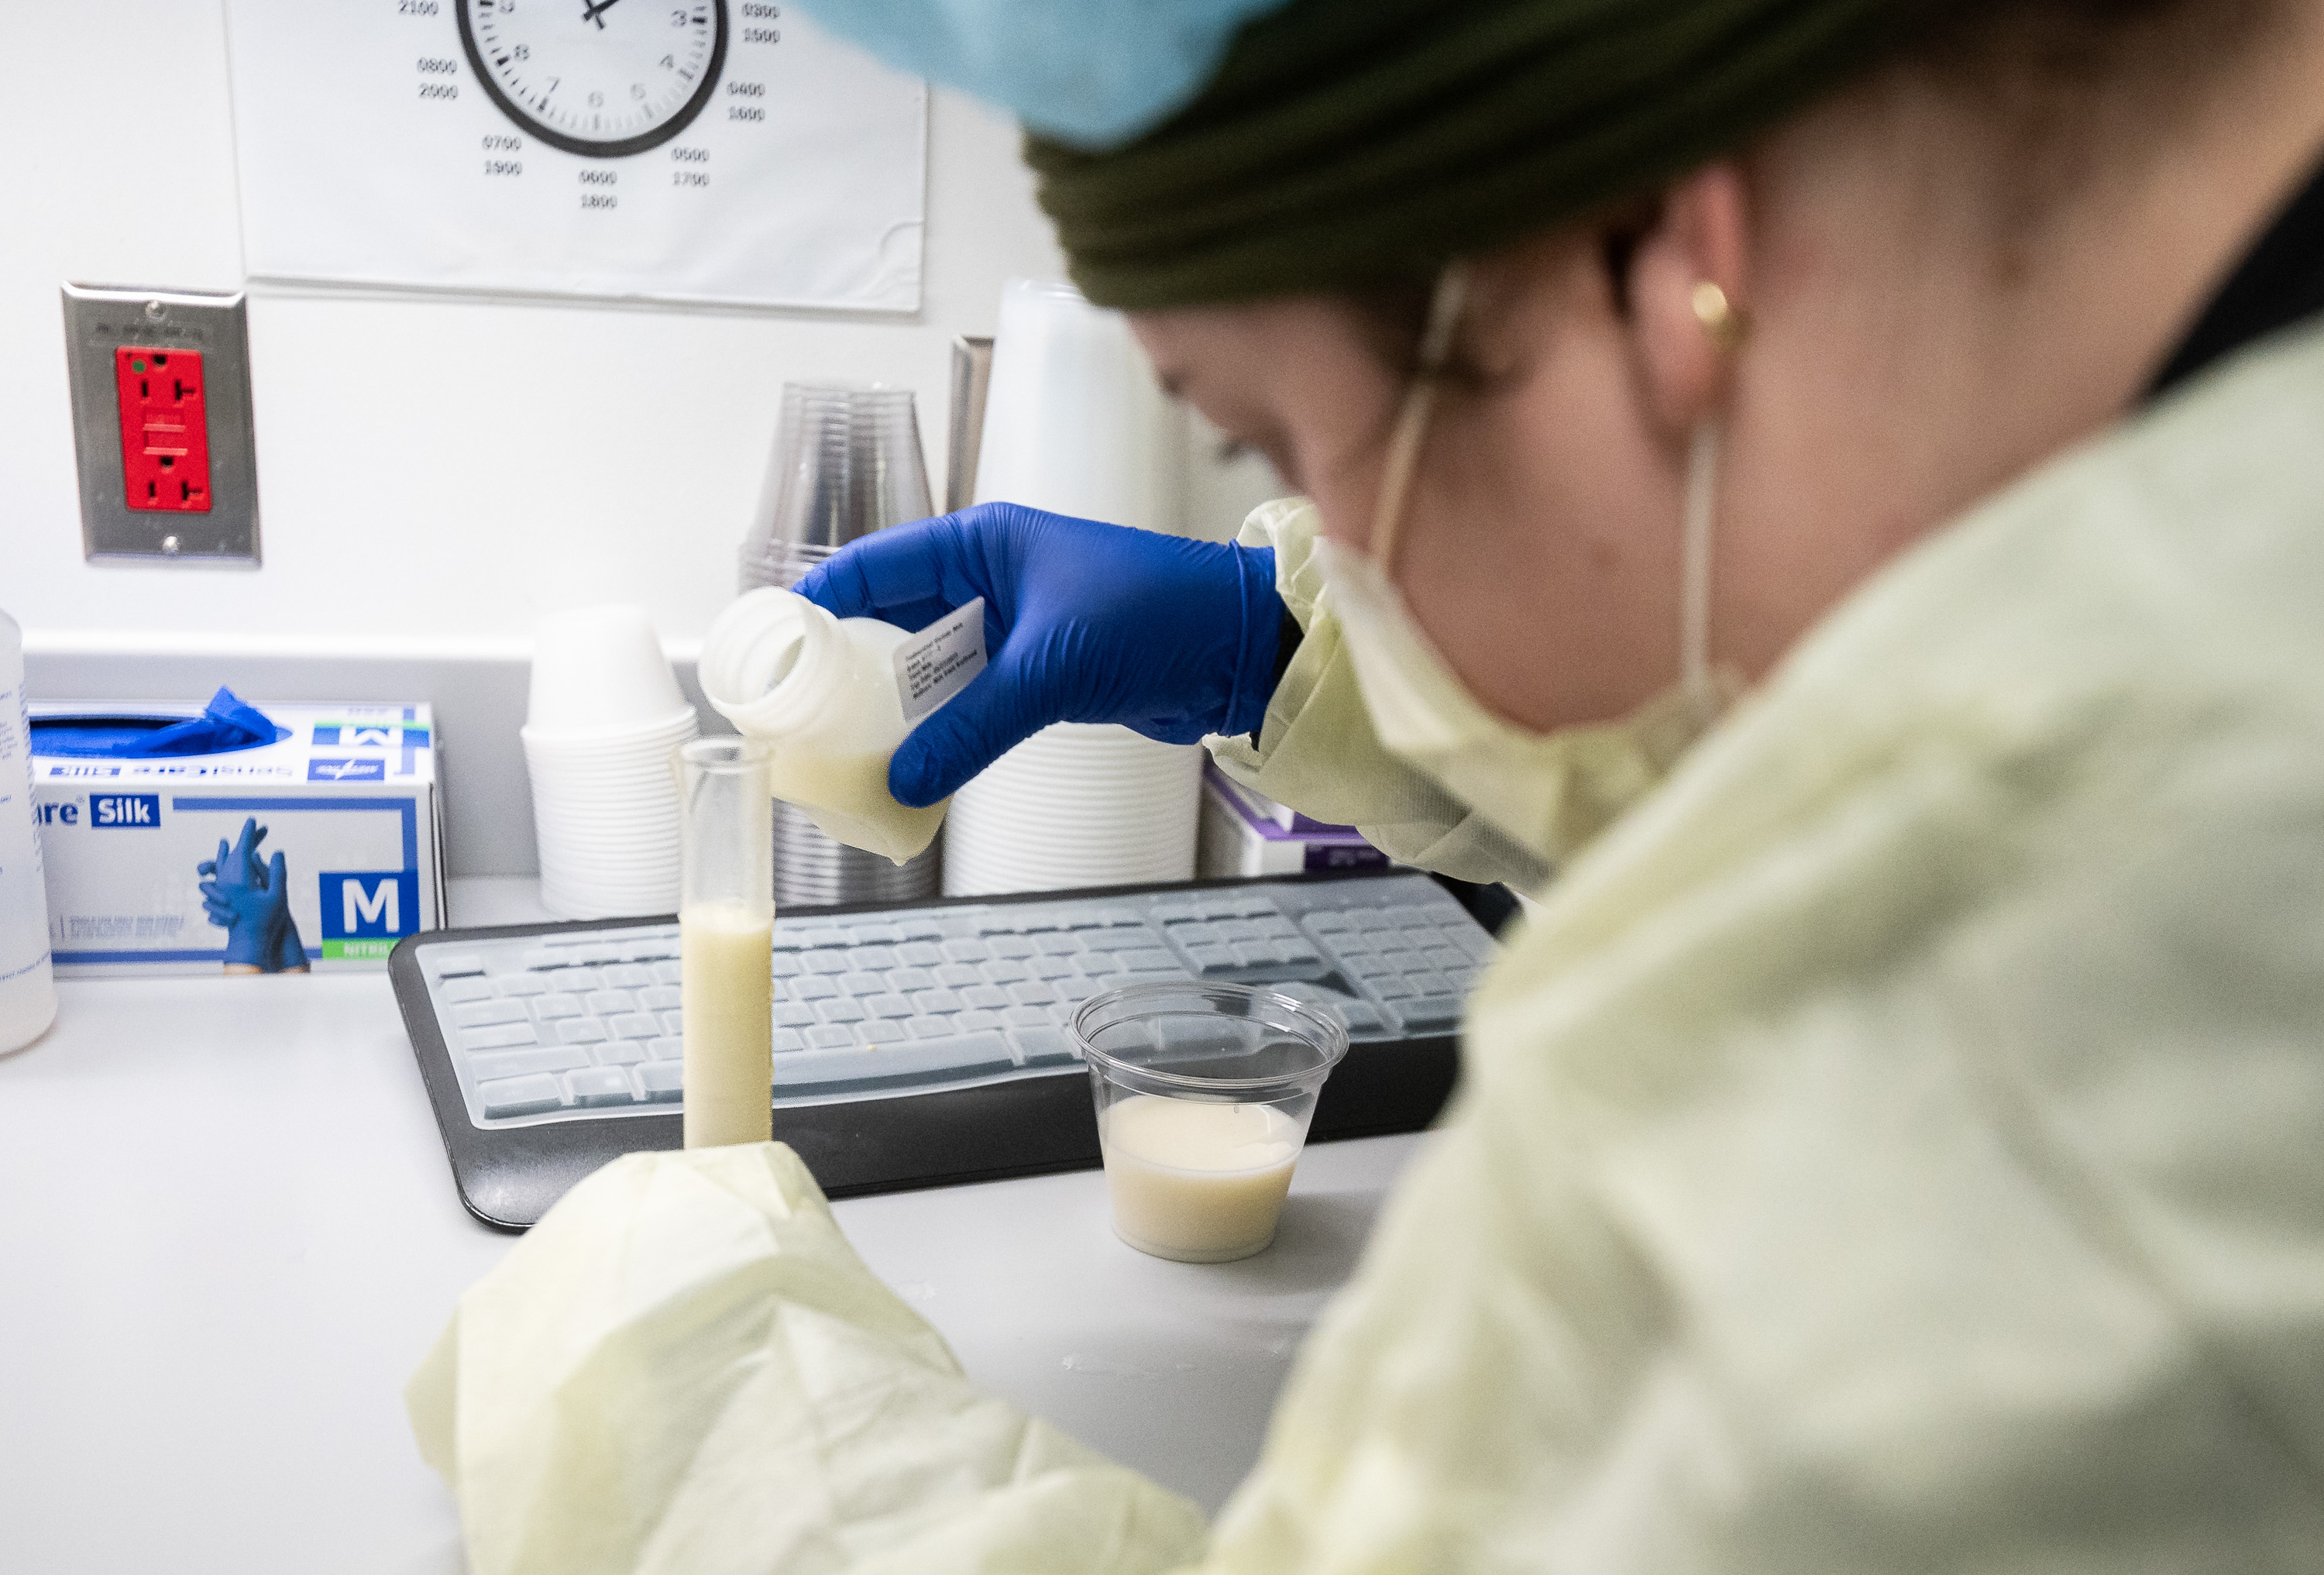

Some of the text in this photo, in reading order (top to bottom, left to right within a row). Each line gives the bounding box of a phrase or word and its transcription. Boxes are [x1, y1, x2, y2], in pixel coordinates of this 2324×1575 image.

[672, 9, 687, 27] 3
[514, 43, 530, 61] 8
[418, 57, 457, 74] 0800
[659, 54, 675, 70] 4
[419, 82, 459, 100] 2000
[548, 76, 562, 95] 7
[588, 91, 604, 108] 6
[483, 134, 522, 152] 0700
[672, 146, 710, 162] 0500
[484, 160, 522, 177] 1900
[673, 170, 710, 187] 1700
[98, 796, 151, 824] Silk
[342, 879, 400, 934] M
